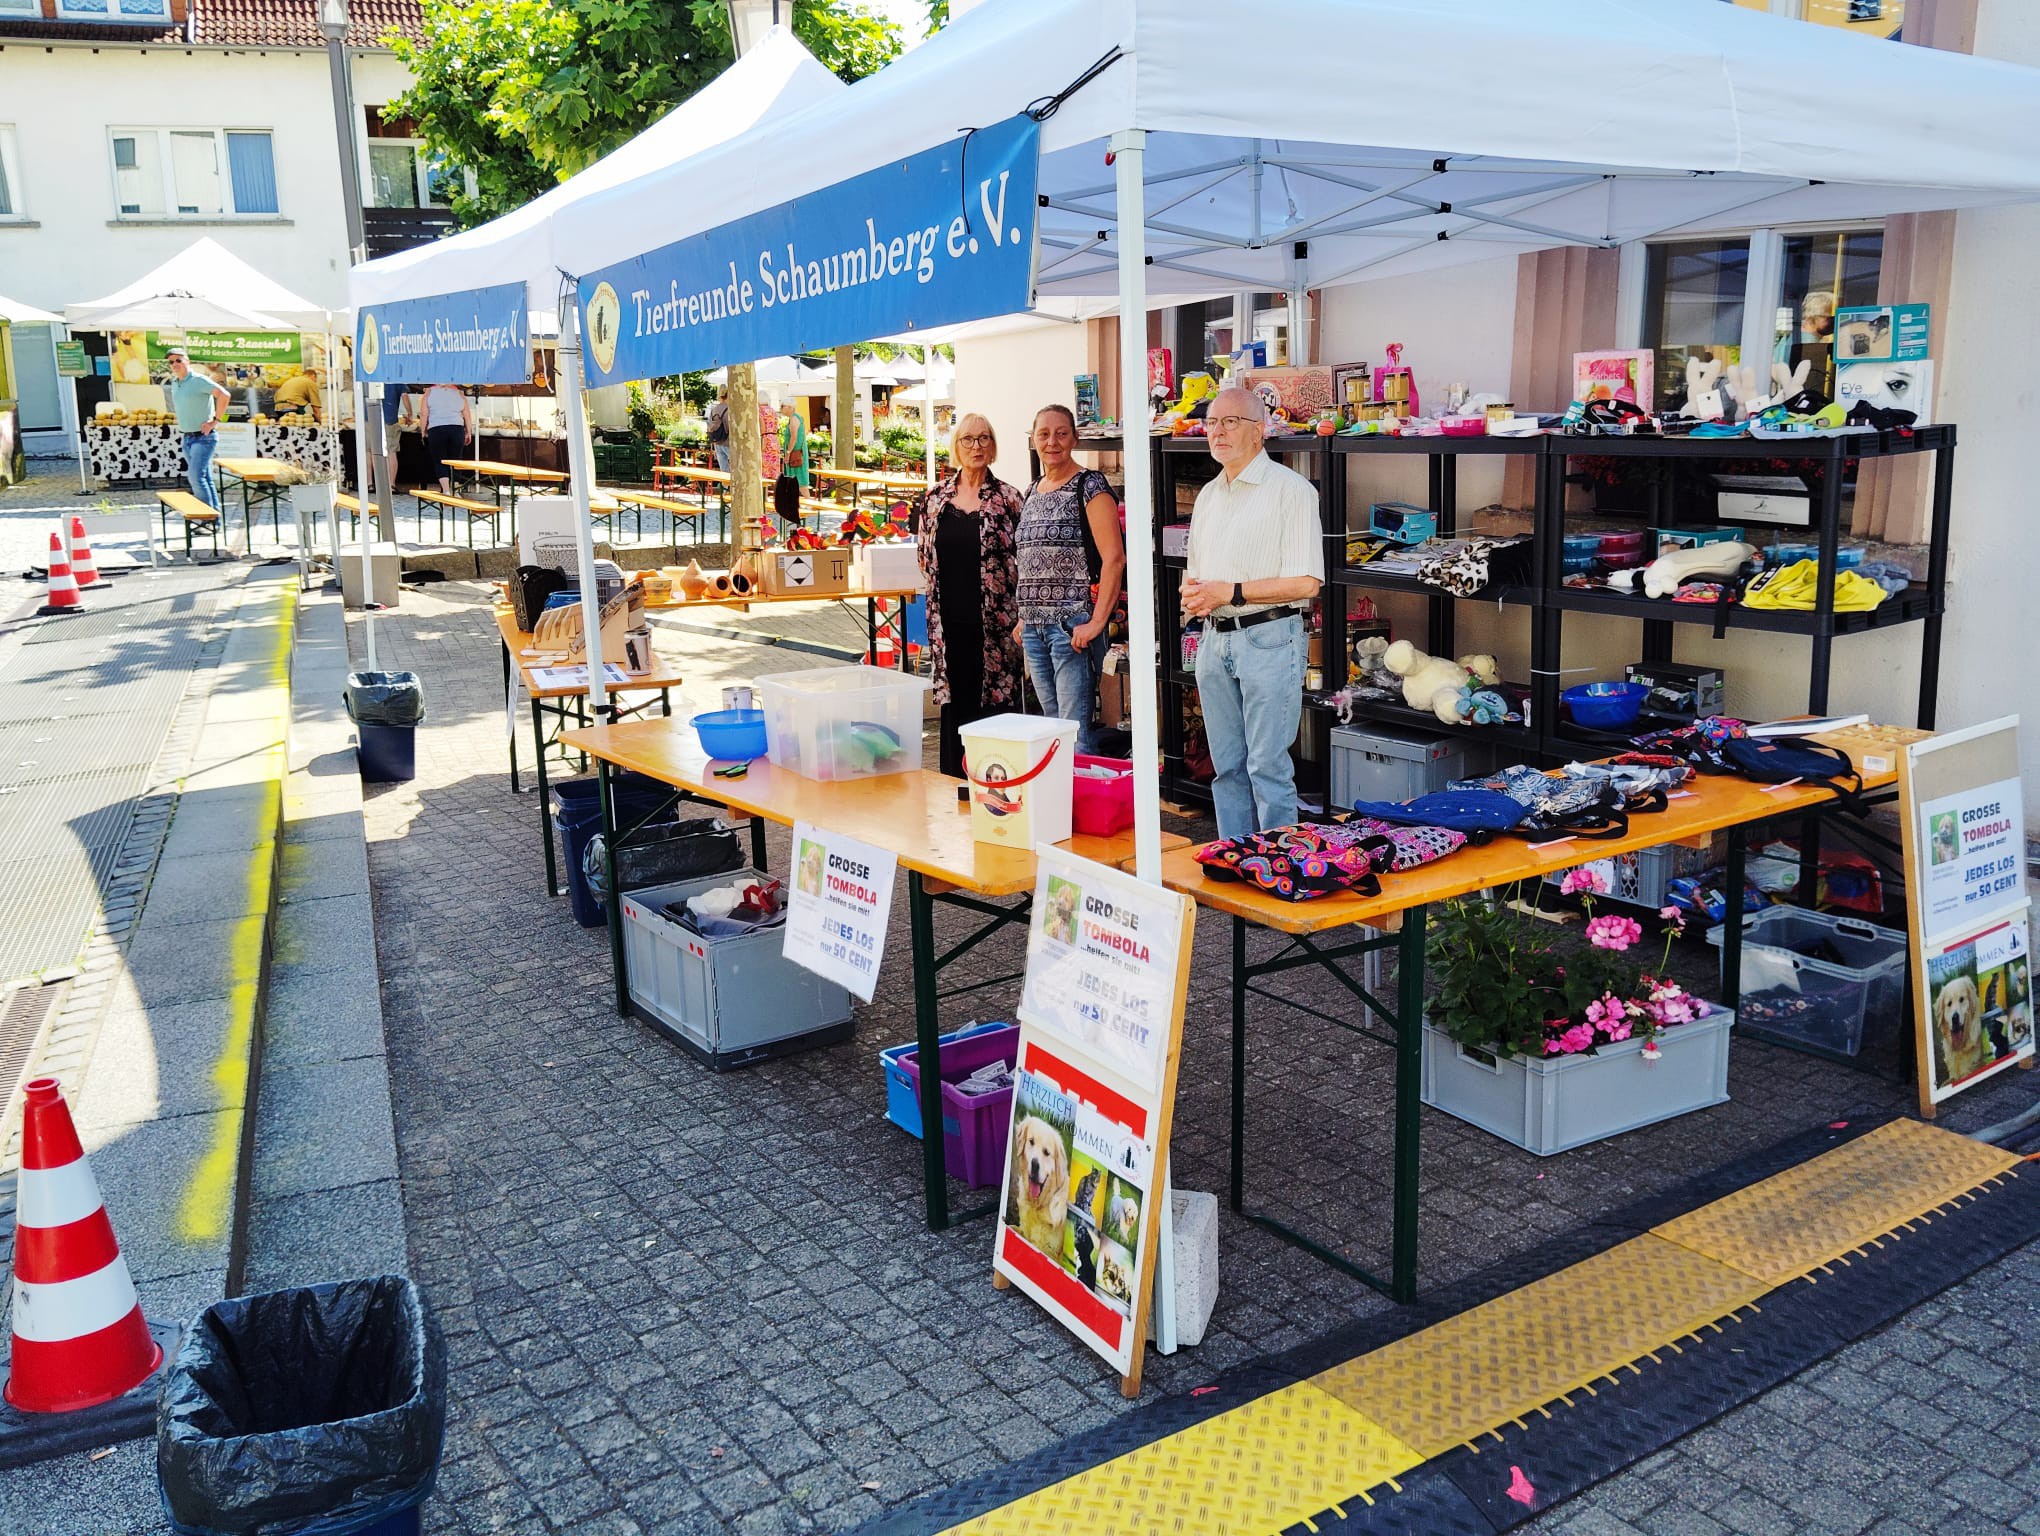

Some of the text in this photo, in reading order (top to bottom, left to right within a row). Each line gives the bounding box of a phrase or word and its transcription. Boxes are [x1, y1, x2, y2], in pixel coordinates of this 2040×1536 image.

[631, 261, 754, 339] Tierfreunde
[758, 217, 940, 309] Schaumberg
[382, 320, 434, 355] Tierfreunde
[434, 314, 499, 359] Schaumberg
[1841, 383, 1863, 395] Eye
[1962, 802, 2001, 824] GROSSE
[1963, 819, 2011, 843] TOMBOLA
[828, 853, 870, 880] GROSSE
[1964, 861, 1995, 882] JEDES
[1997, 855, 2015, 872] LOS
[826, 875, 877, 906] TOMBOLA
[1965, 874, 2017, 902] nur 50 CENT
[1085, 895, 1139, 930] GROSSE
[822, 916, 853, 941] JEDES
[855, 931, 875, 950] LOS
[1083, 920, 1150, 963] TOMBOLA
[820, 941, 873, 973] nur 50 CENT
[1930, 943, 1975, 973] HERZLICH
[1077, 970, 1118, 1000] JEDES
[1122, 991, 1149, 1016] LOS
[1073, 999, 1149, 1045] nur 50 CENT
[1022, 1073, 1072, 1118] HERZLICH
[1038, 1102, 1113, 1159] WILLKOMMEN
